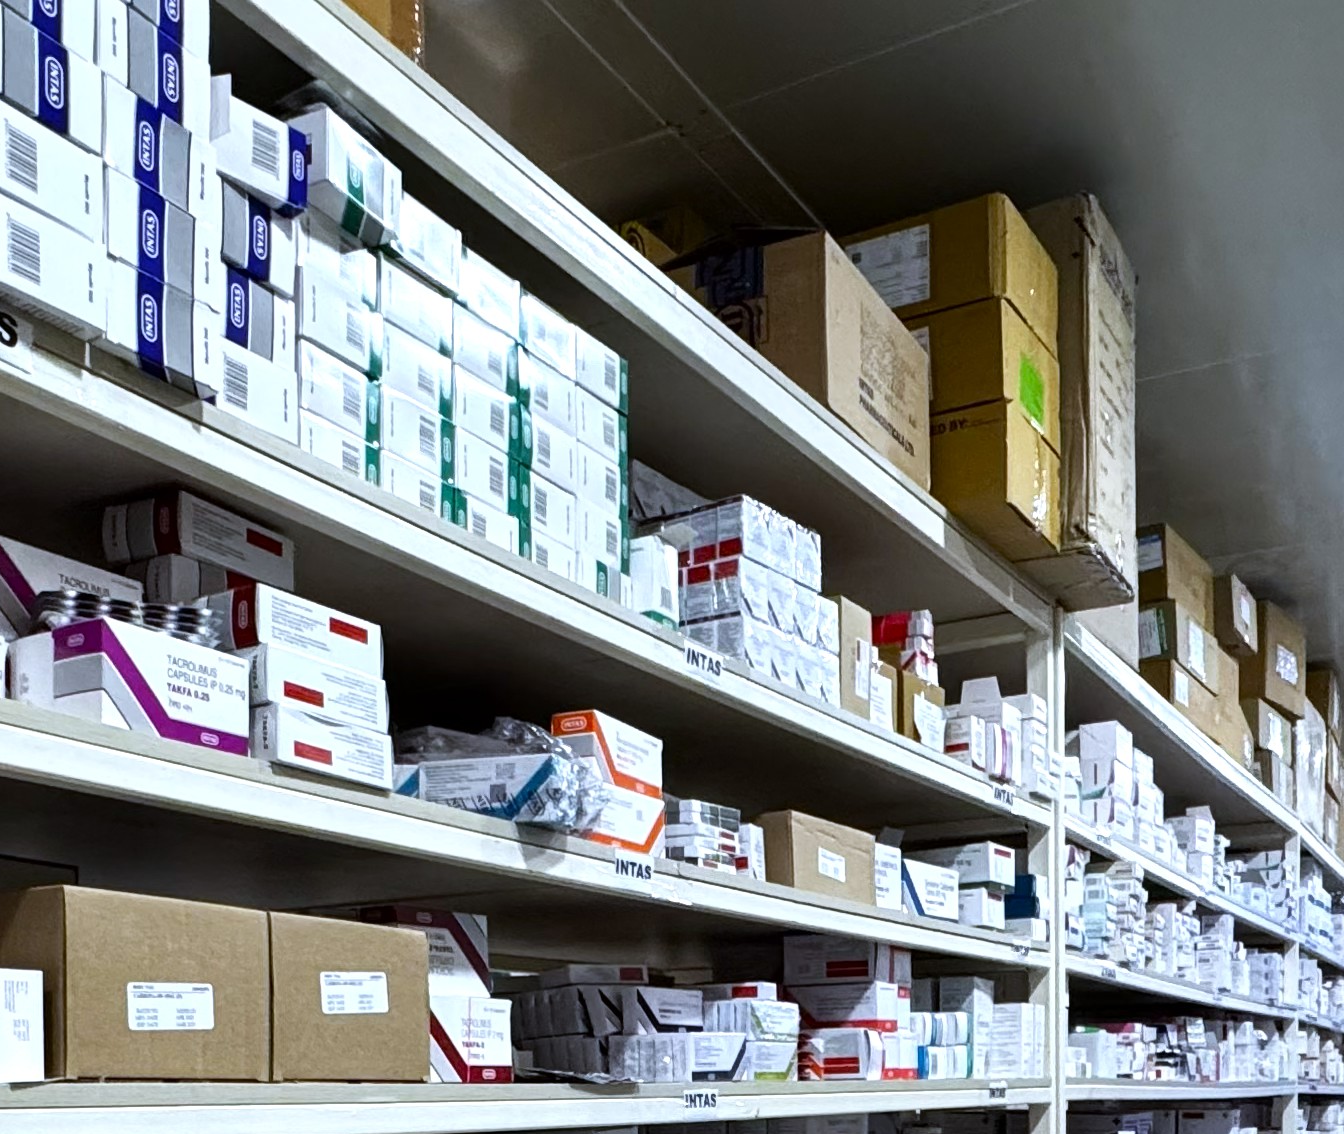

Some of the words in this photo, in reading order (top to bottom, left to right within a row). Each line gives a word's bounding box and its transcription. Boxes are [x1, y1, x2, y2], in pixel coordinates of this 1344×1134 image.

[48, 62, 62, 104] INTAS
[146, 214, 156, 256] INTAS
[144, 299, 155, 340] INTAS
[167, 654, 217, 678] TACROLIMUS
[686, 649, 722, 676] INTAS
[167, 668, 208, 689] CAPSULES
[615, 859, 651, 880] INTAS
